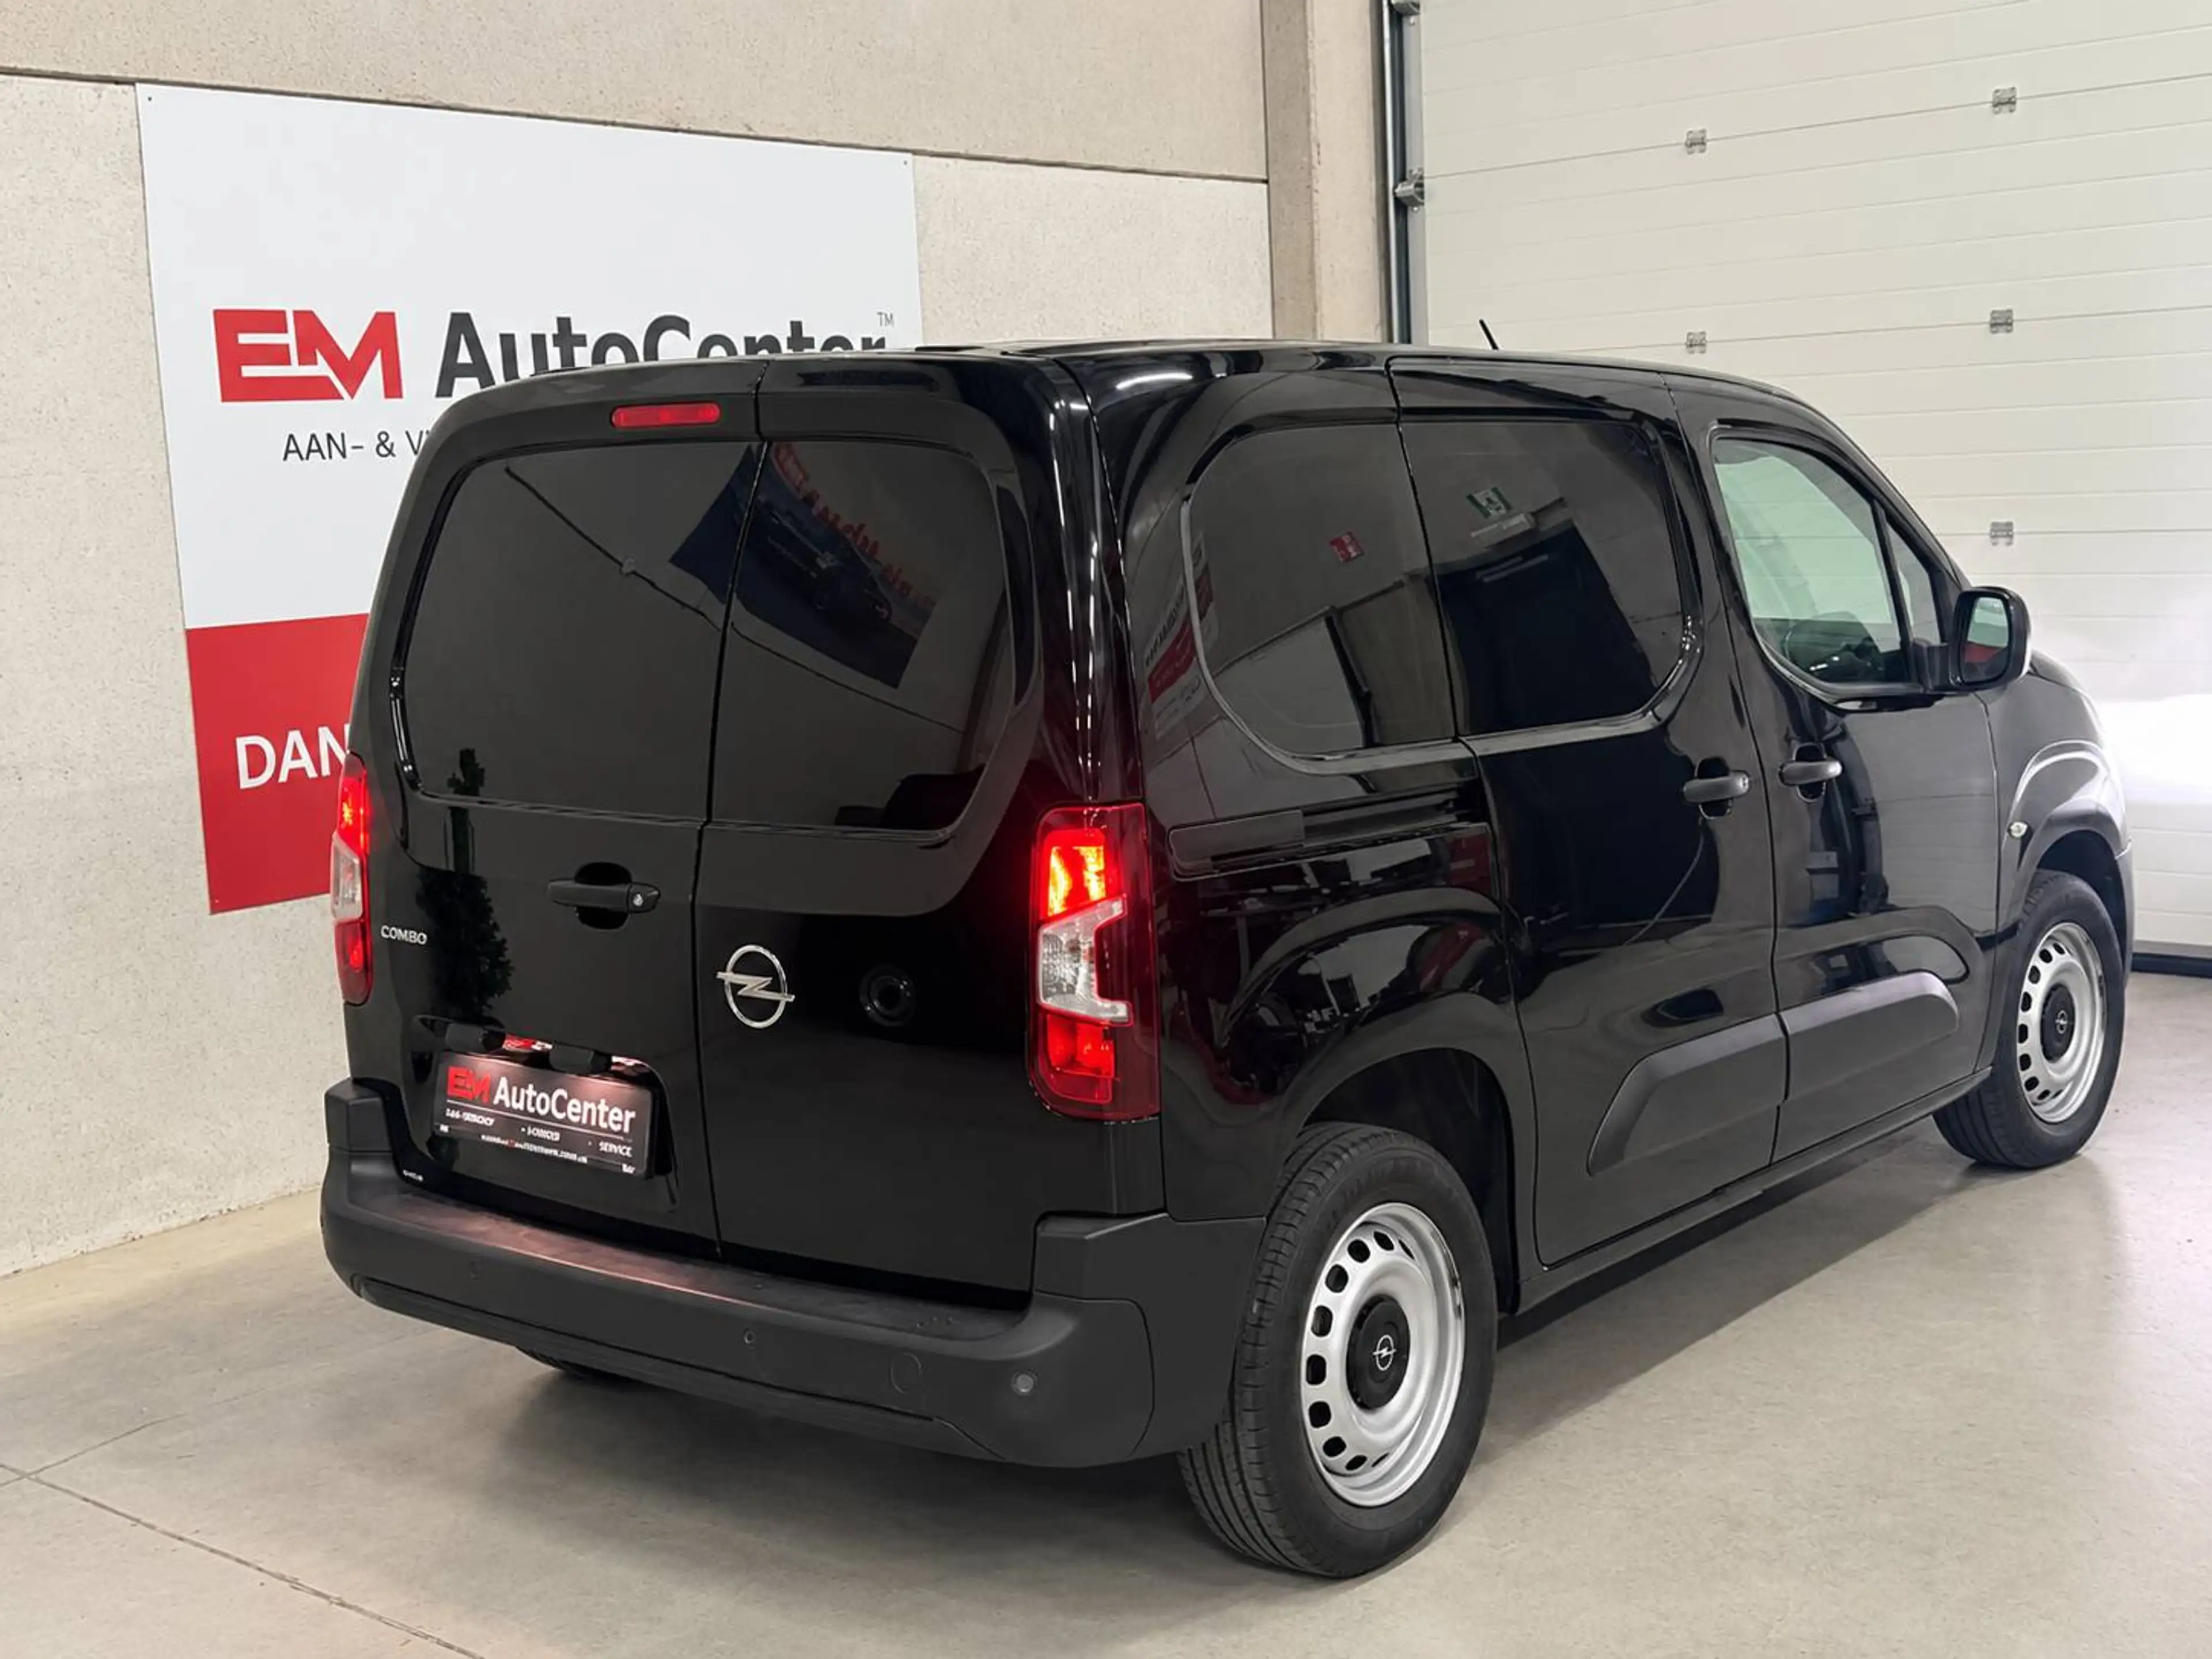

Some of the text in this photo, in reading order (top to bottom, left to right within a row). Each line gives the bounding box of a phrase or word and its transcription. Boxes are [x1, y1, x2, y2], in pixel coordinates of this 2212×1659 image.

[213, 309, 403, 402] EM
[283, 433, 363, 461] AAN-
[376, 431, 396, 457] &
[381, 925, 427, 945] COMBO
[493, 1076, 636, 1133] AutoCenter
